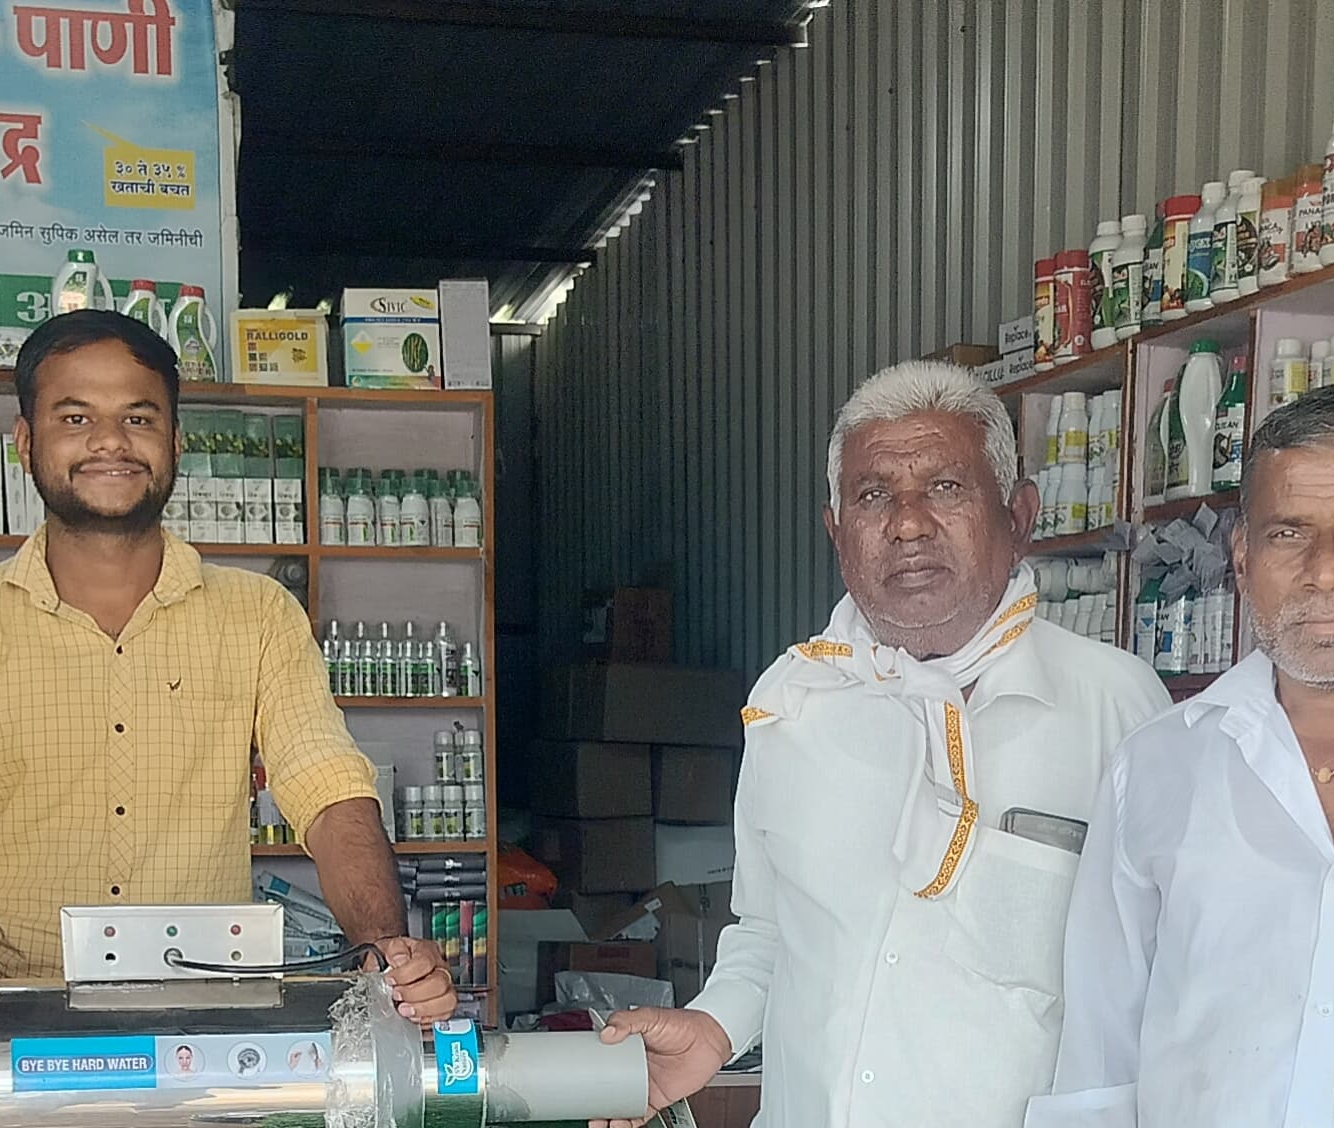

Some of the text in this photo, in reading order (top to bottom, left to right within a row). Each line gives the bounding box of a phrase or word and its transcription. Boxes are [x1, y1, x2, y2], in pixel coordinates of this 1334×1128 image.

[110, 178, 155, 197] खताची
[39, 223, 79, 245] सुपिक
[83, 225, 119, 244] असेल
[124, 230, 143, 245] तर
[147, 229, 204, 248] जमिनीची
[246, 330, 309, 343] RALLIGOLD
[20, 1055, 148, 1073] BYE BYE HARD WATER
